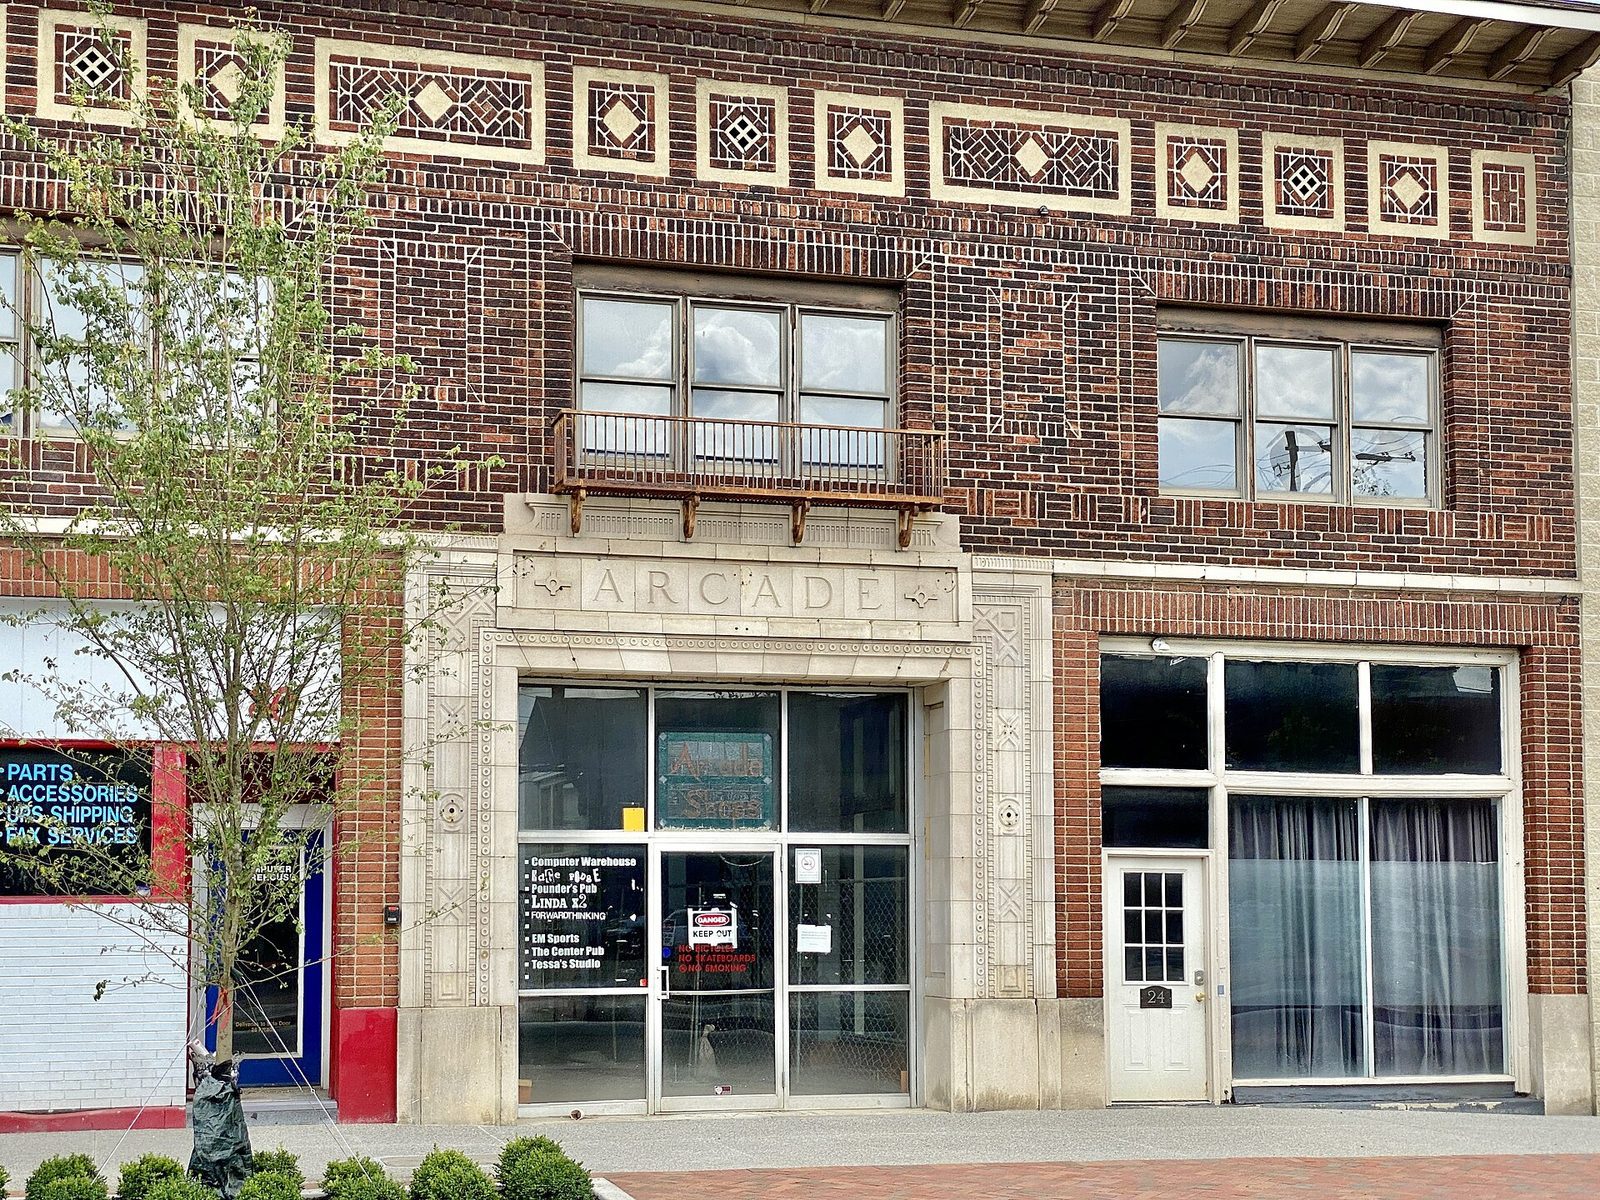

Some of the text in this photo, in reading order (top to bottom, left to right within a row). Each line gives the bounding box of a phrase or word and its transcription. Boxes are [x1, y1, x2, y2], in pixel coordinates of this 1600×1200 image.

[592, 568, 882, 611] ARCADE
[7, 763, 73, 781] PARTS
[7, 784, 138, 803] ACCESSORIES
[7, 805, 133, 823] UPS SHIPPING
[6, 826, 137, 844] FAX SERVICES
[531, 856, 637, 867] Computer Warehouse
[531, 884, 597, 893] Pounder's Pub
[531, 911, 606, 921] FORWARDTHINKING
[697, 916, 727, 924] DANGER
[531, 933, 580, 944] EM Sports
[692, 929, 732, 938] KEEP OUT
[531, 946, 605, 956] The Center Pub
[678, 944, 692, 952] NO
[531, 958, 601, 969] Tessa's Studio
[678, 954, 756, 962] NO SKATEBOARDS
[688, 964, 747, 972] NO SMOKING
[1147, 990, 1165, 1004] 24
